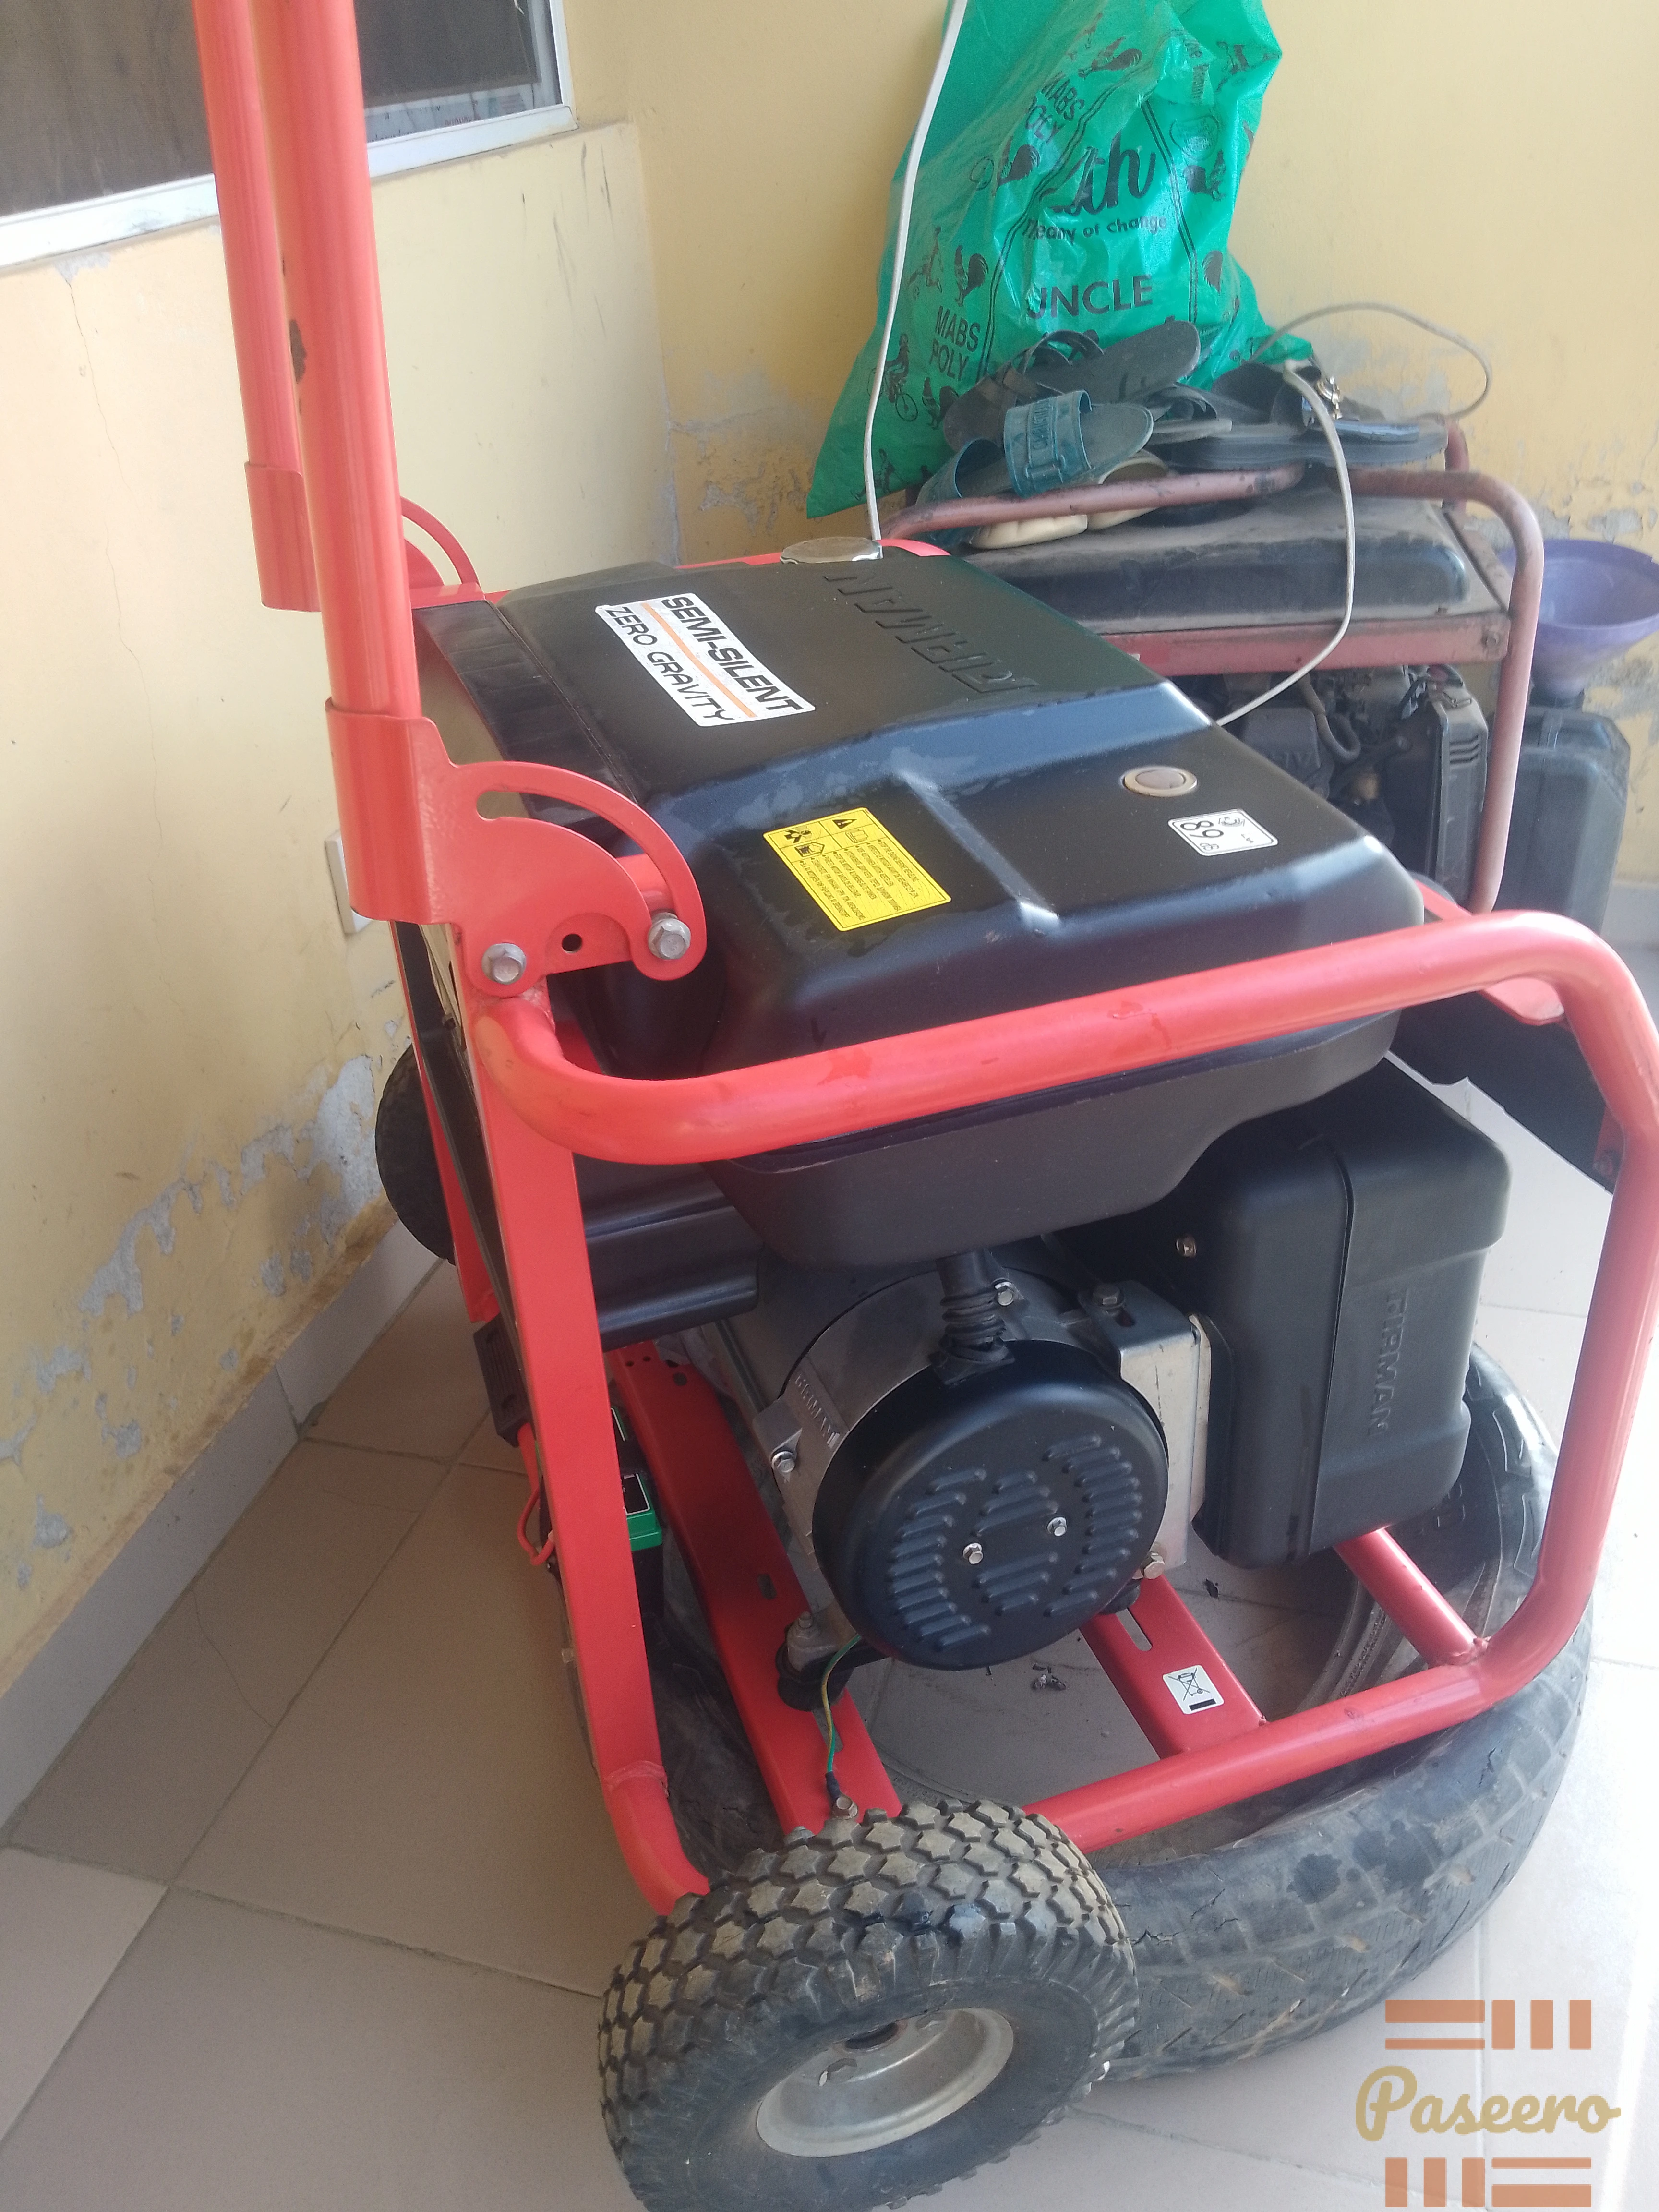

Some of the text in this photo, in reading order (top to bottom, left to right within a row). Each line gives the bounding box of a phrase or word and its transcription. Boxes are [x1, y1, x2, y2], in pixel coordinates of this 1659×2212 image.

[1041, 72, 1084, 121] MABS
[1027, 275, 1154, 320] UNCLE
[935, 305, 981, 352] MABS
[930, 338, 970, 381] POLY
[606, 606, 735, 721] ZERO GRAVITY
[661, 597, 804, 710] SEMI-SILENT
[1179, 820, 1224, 838] 89
